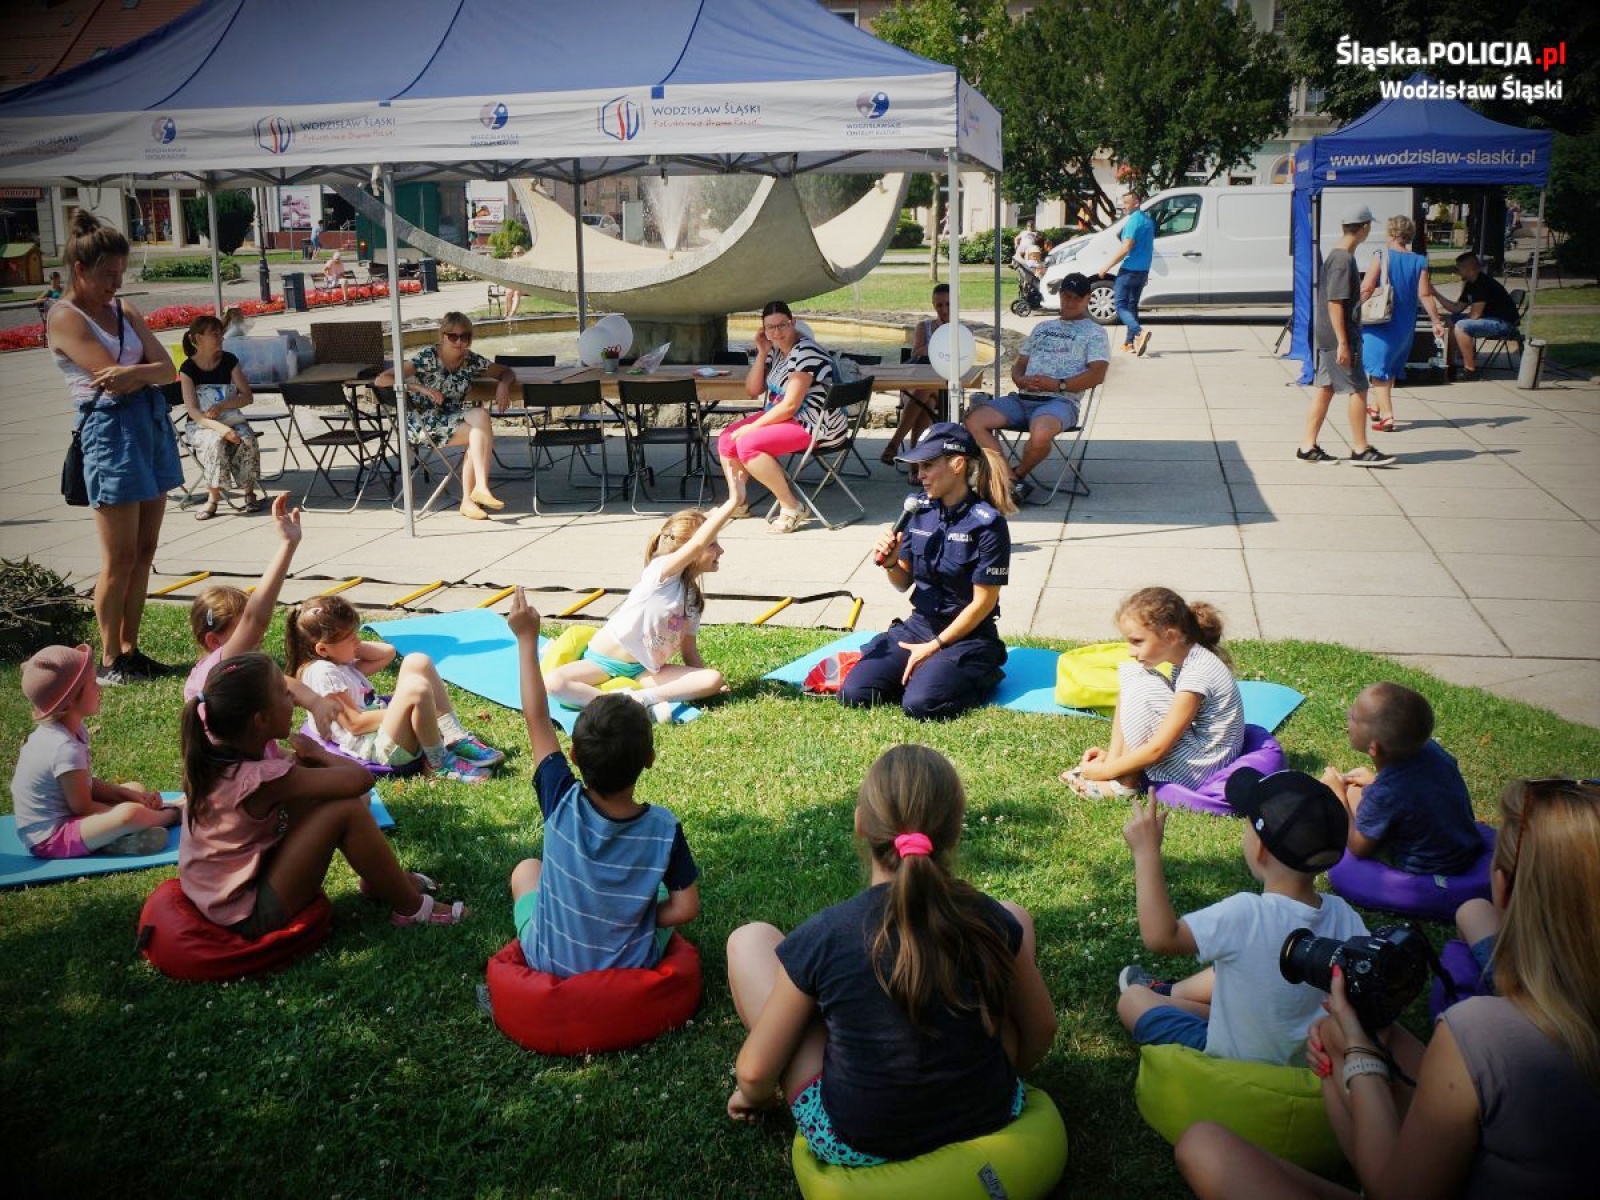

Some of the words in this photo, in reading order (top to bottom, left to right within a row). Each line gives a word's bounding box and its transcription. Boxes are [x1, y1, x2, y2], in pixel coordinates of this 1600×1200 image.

[652, 105, 721, 117] WODZISŁAW
[724, 102, 761, 117] ŚLĄSKI
[301, 118, 361, 131] WODZISŁAW
[364, 116, 396, 129] ŚLĄSKI
[1330, 148, 1536, 168] www.wodzislaw-slaski.pl
